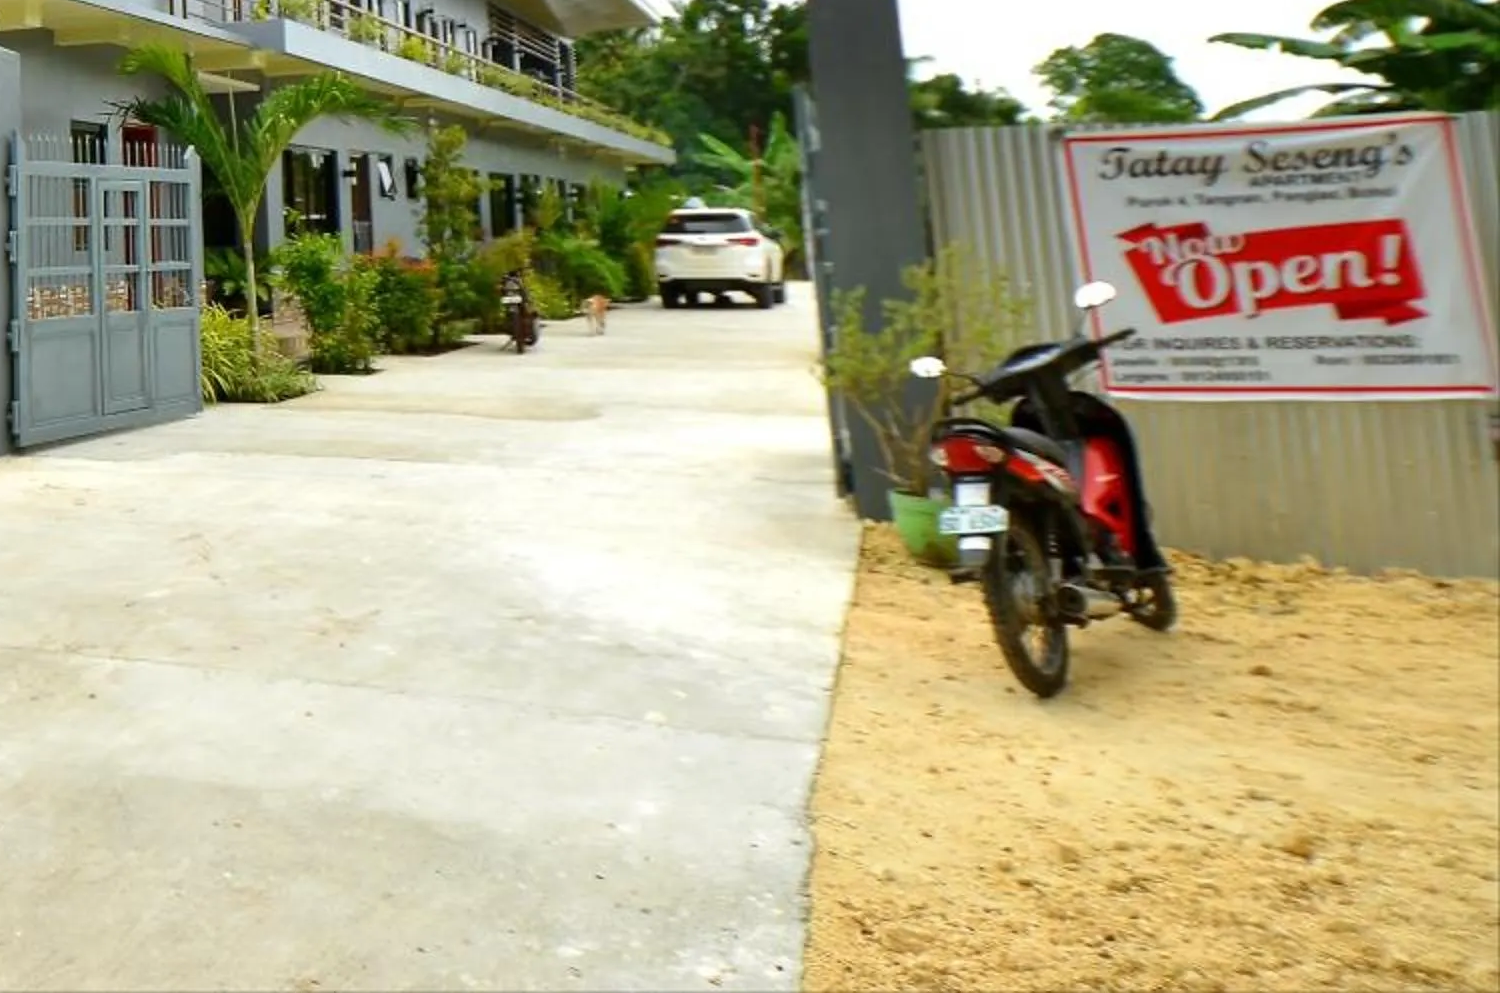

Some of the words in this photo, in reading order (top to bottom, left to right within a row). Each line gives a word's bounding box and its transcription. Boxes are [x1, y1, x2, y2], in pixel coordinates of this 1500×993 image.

[1098, 147, 1228, 186] Tatay
[1243, 132, 1414, 179] Seseng's
[1140, 233, 1246, 265] Now
[1161, 234, 1403, 319] Open!
[1153, 336, 1242, 350] INQUIRES
